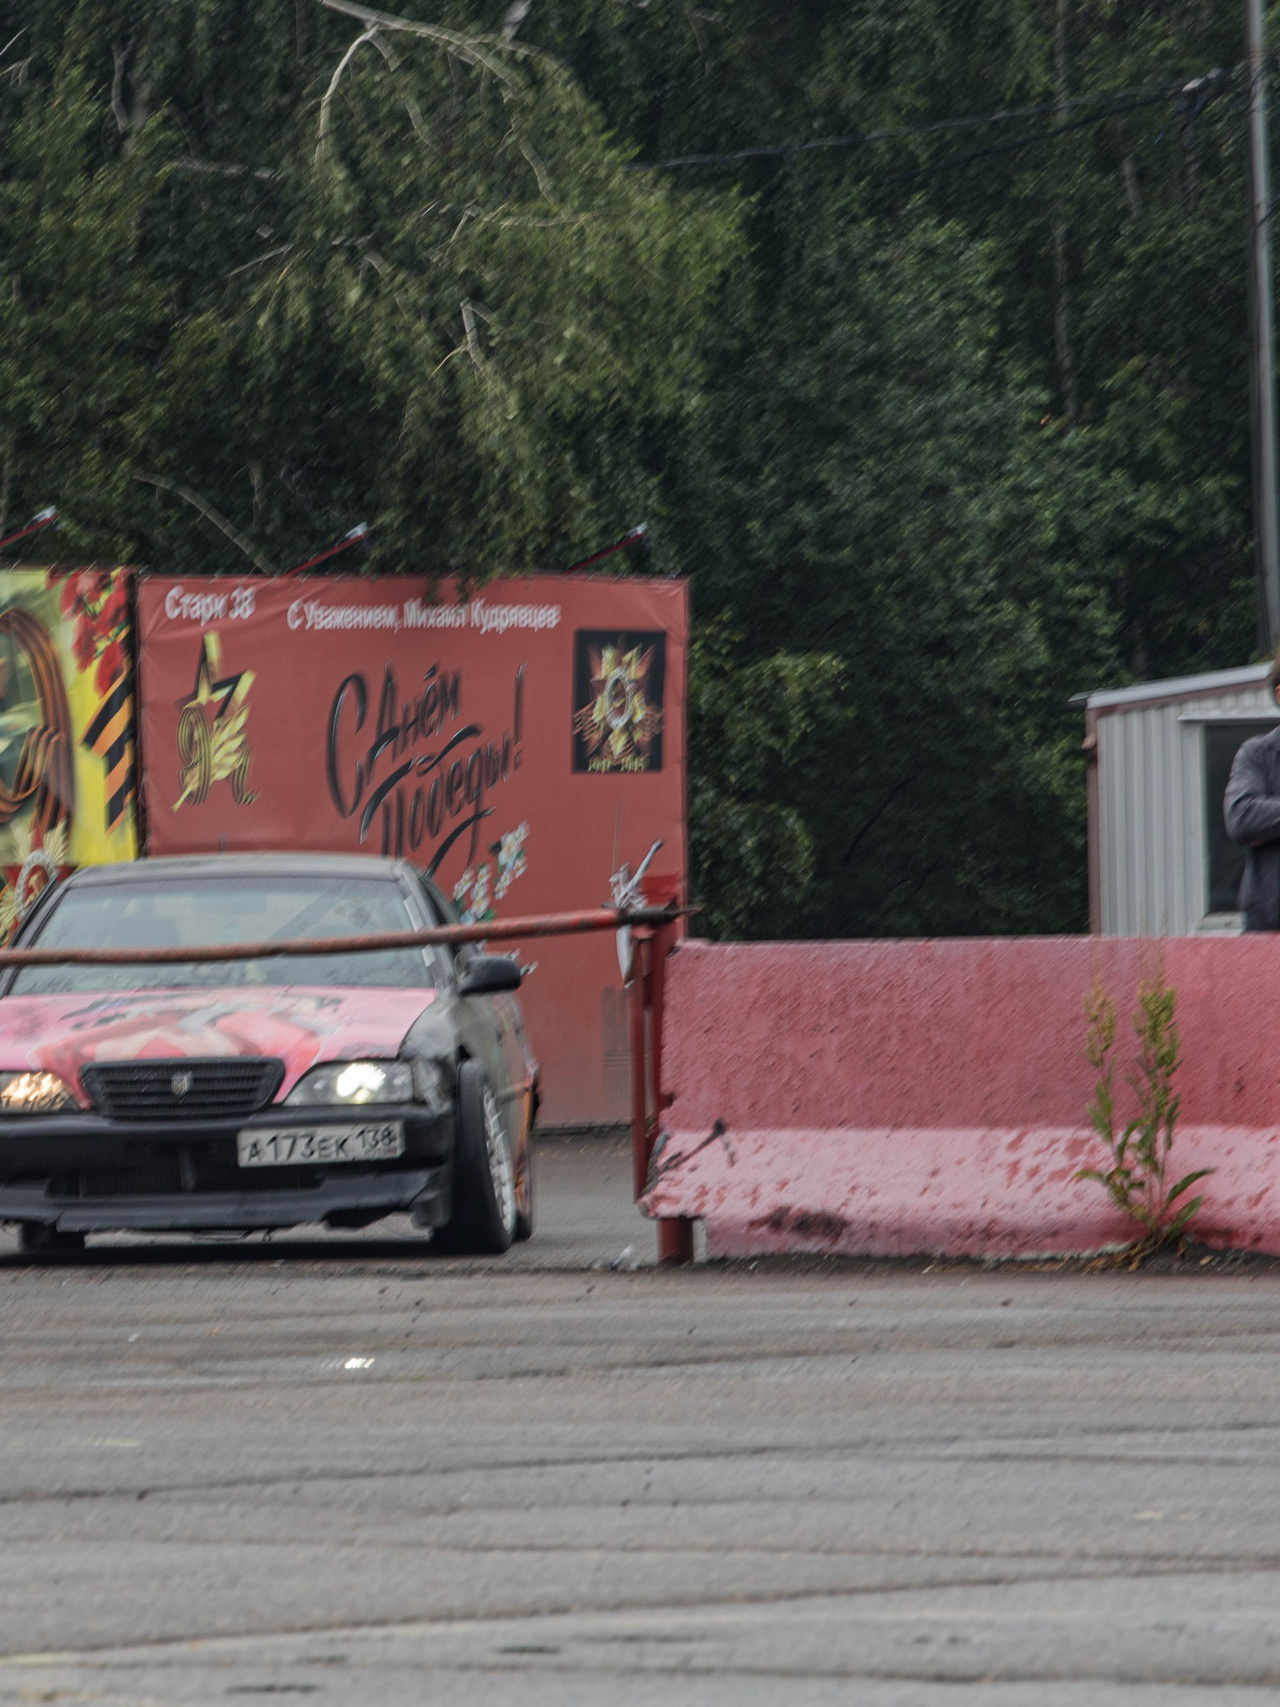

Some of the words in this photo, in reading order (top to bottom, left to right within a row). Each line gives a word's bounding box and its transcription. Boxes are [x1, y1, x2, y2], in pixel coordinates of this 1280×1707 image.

[229, 585, 257, 619] 38
[287, 599, 304, 631] С
[403, 598, 468, 629] Михаил
[470, 598, 561, 634] Кудрявцев
[356, 1123, 397, 1149] 138
